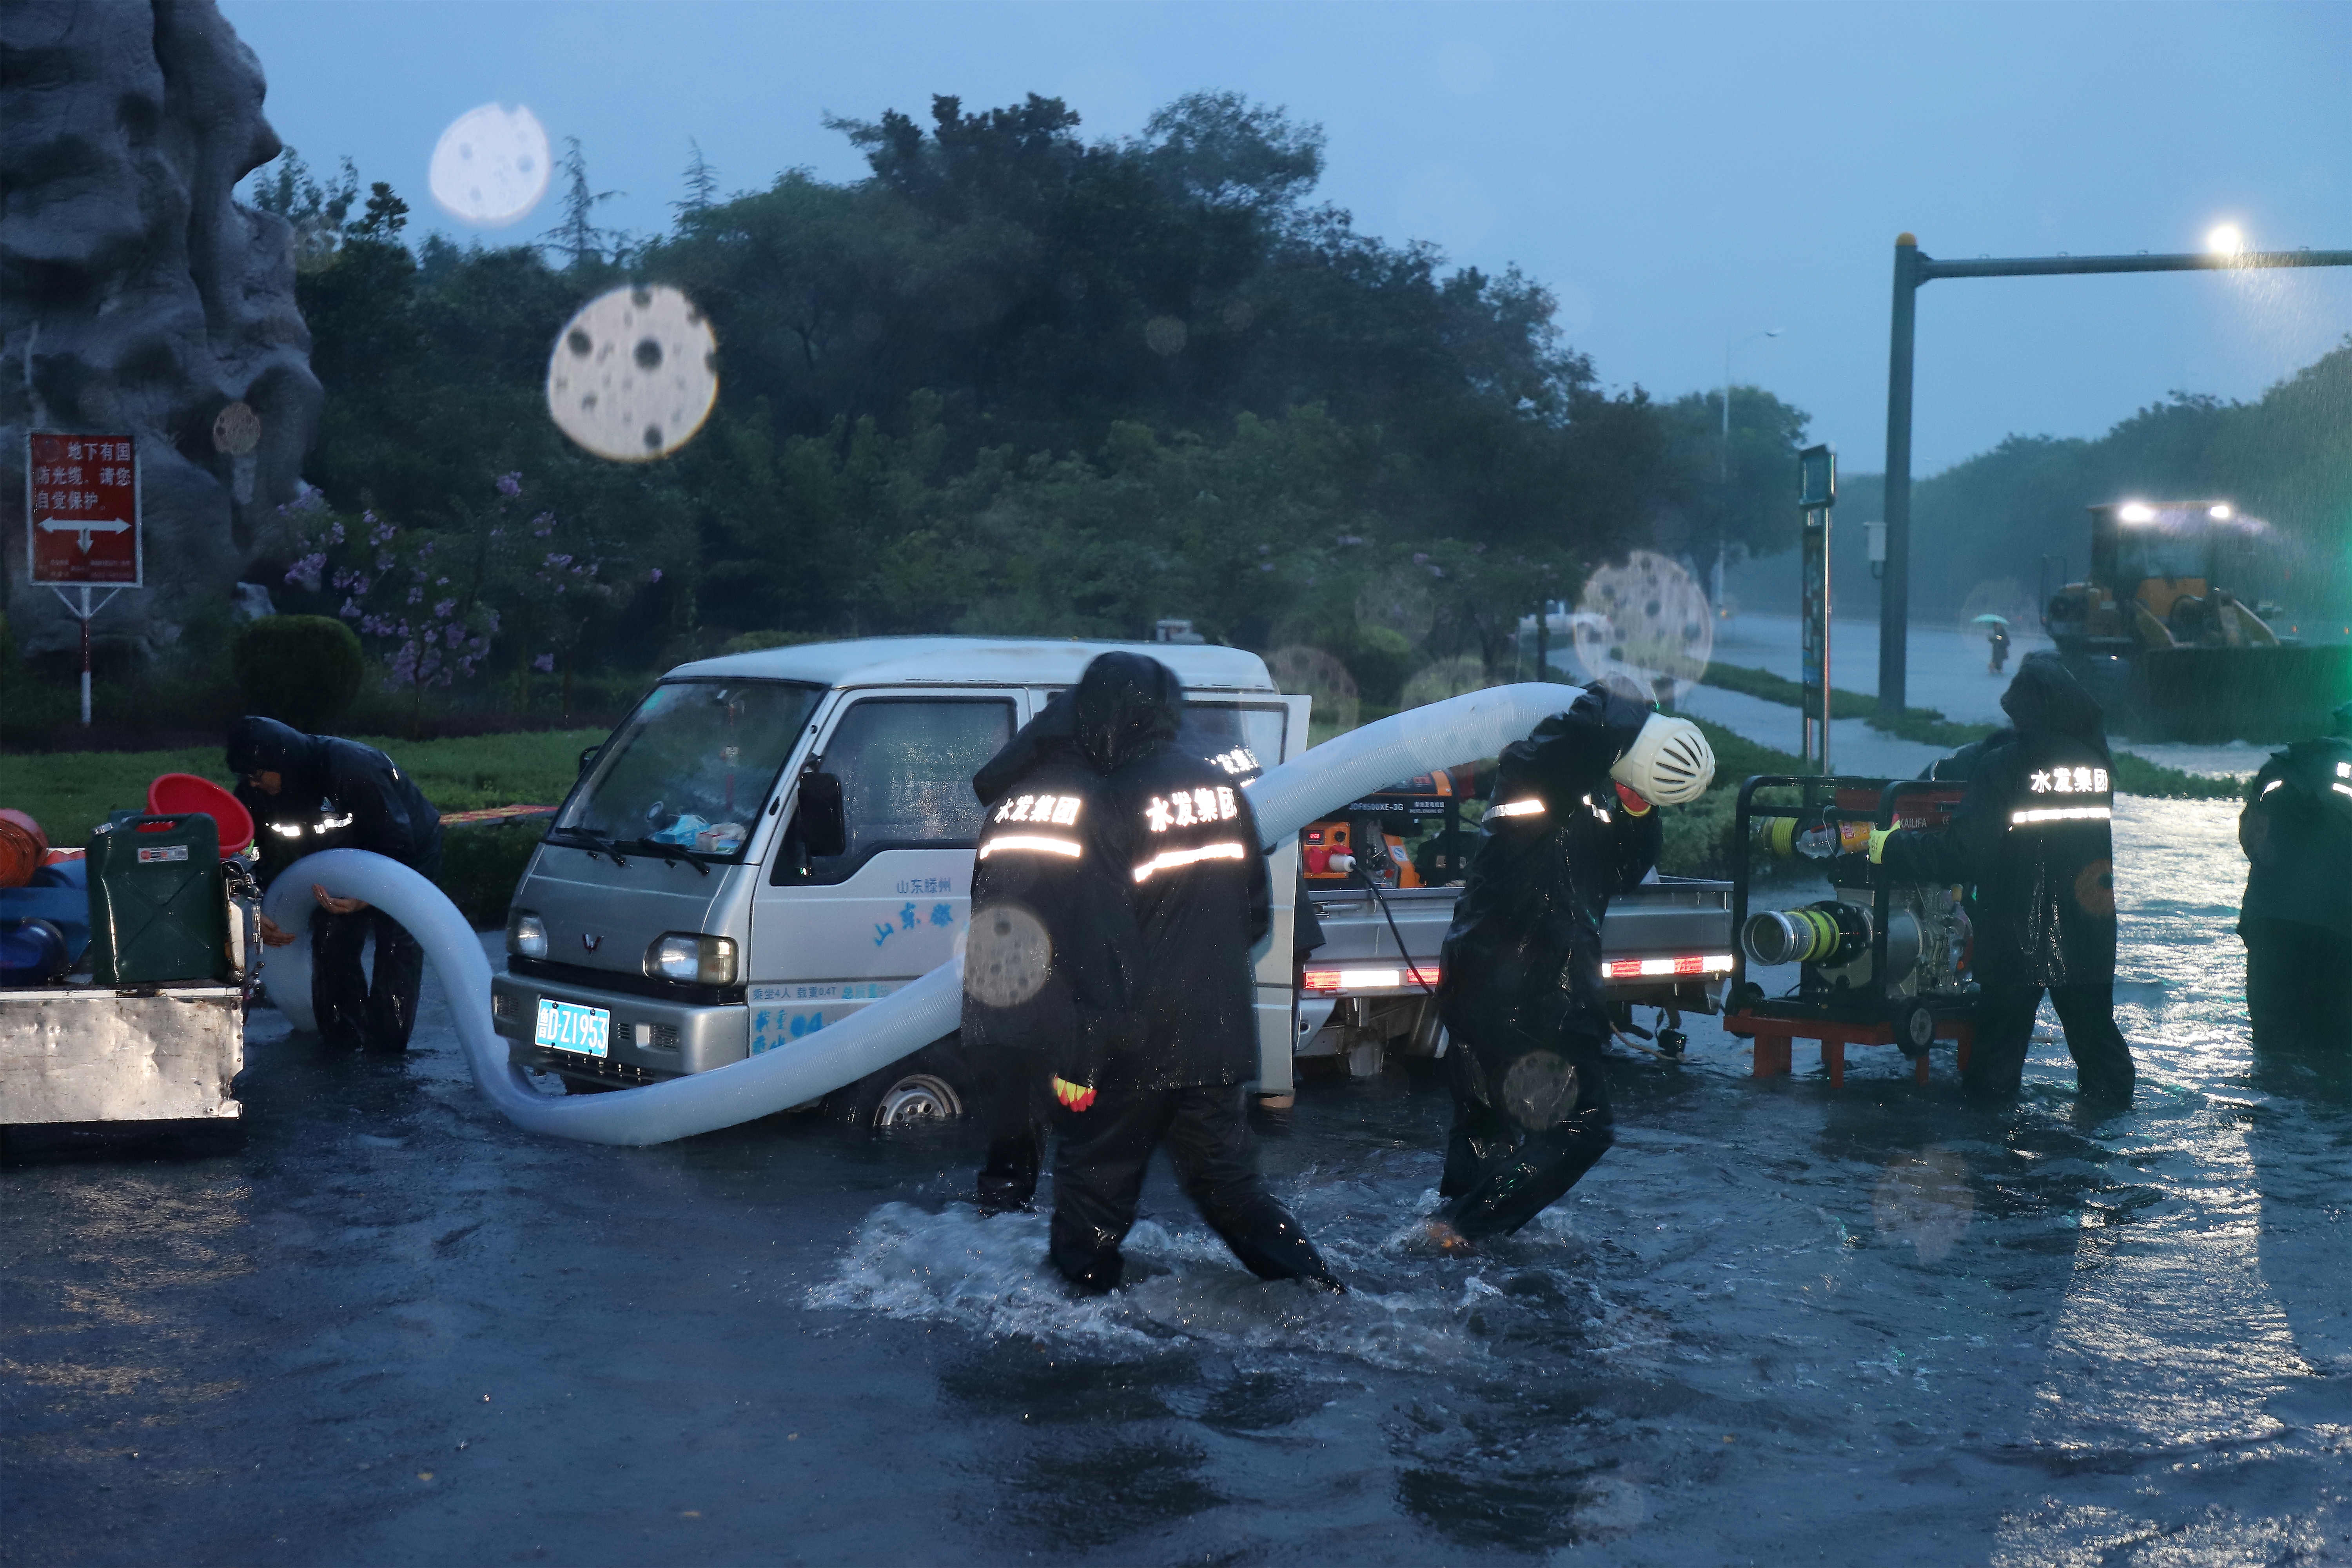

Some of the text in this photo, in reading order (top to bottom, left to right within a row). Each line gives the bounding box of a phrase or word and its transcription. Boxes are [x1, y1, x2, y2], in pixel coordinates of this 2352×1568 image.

[67, 442, 130, 461] 地下有国
[2031, 767, 2108, 793] 水发集团
[994, 795, 1081, 826] 水发集团
[1146, 786, 1237, 832] 水发集团
[1900, 818, 1927, 828] KAILIFA
[897, 877, 951, 894] 山东滕州
[753, 988, 791, 1000] 乘坐4人
